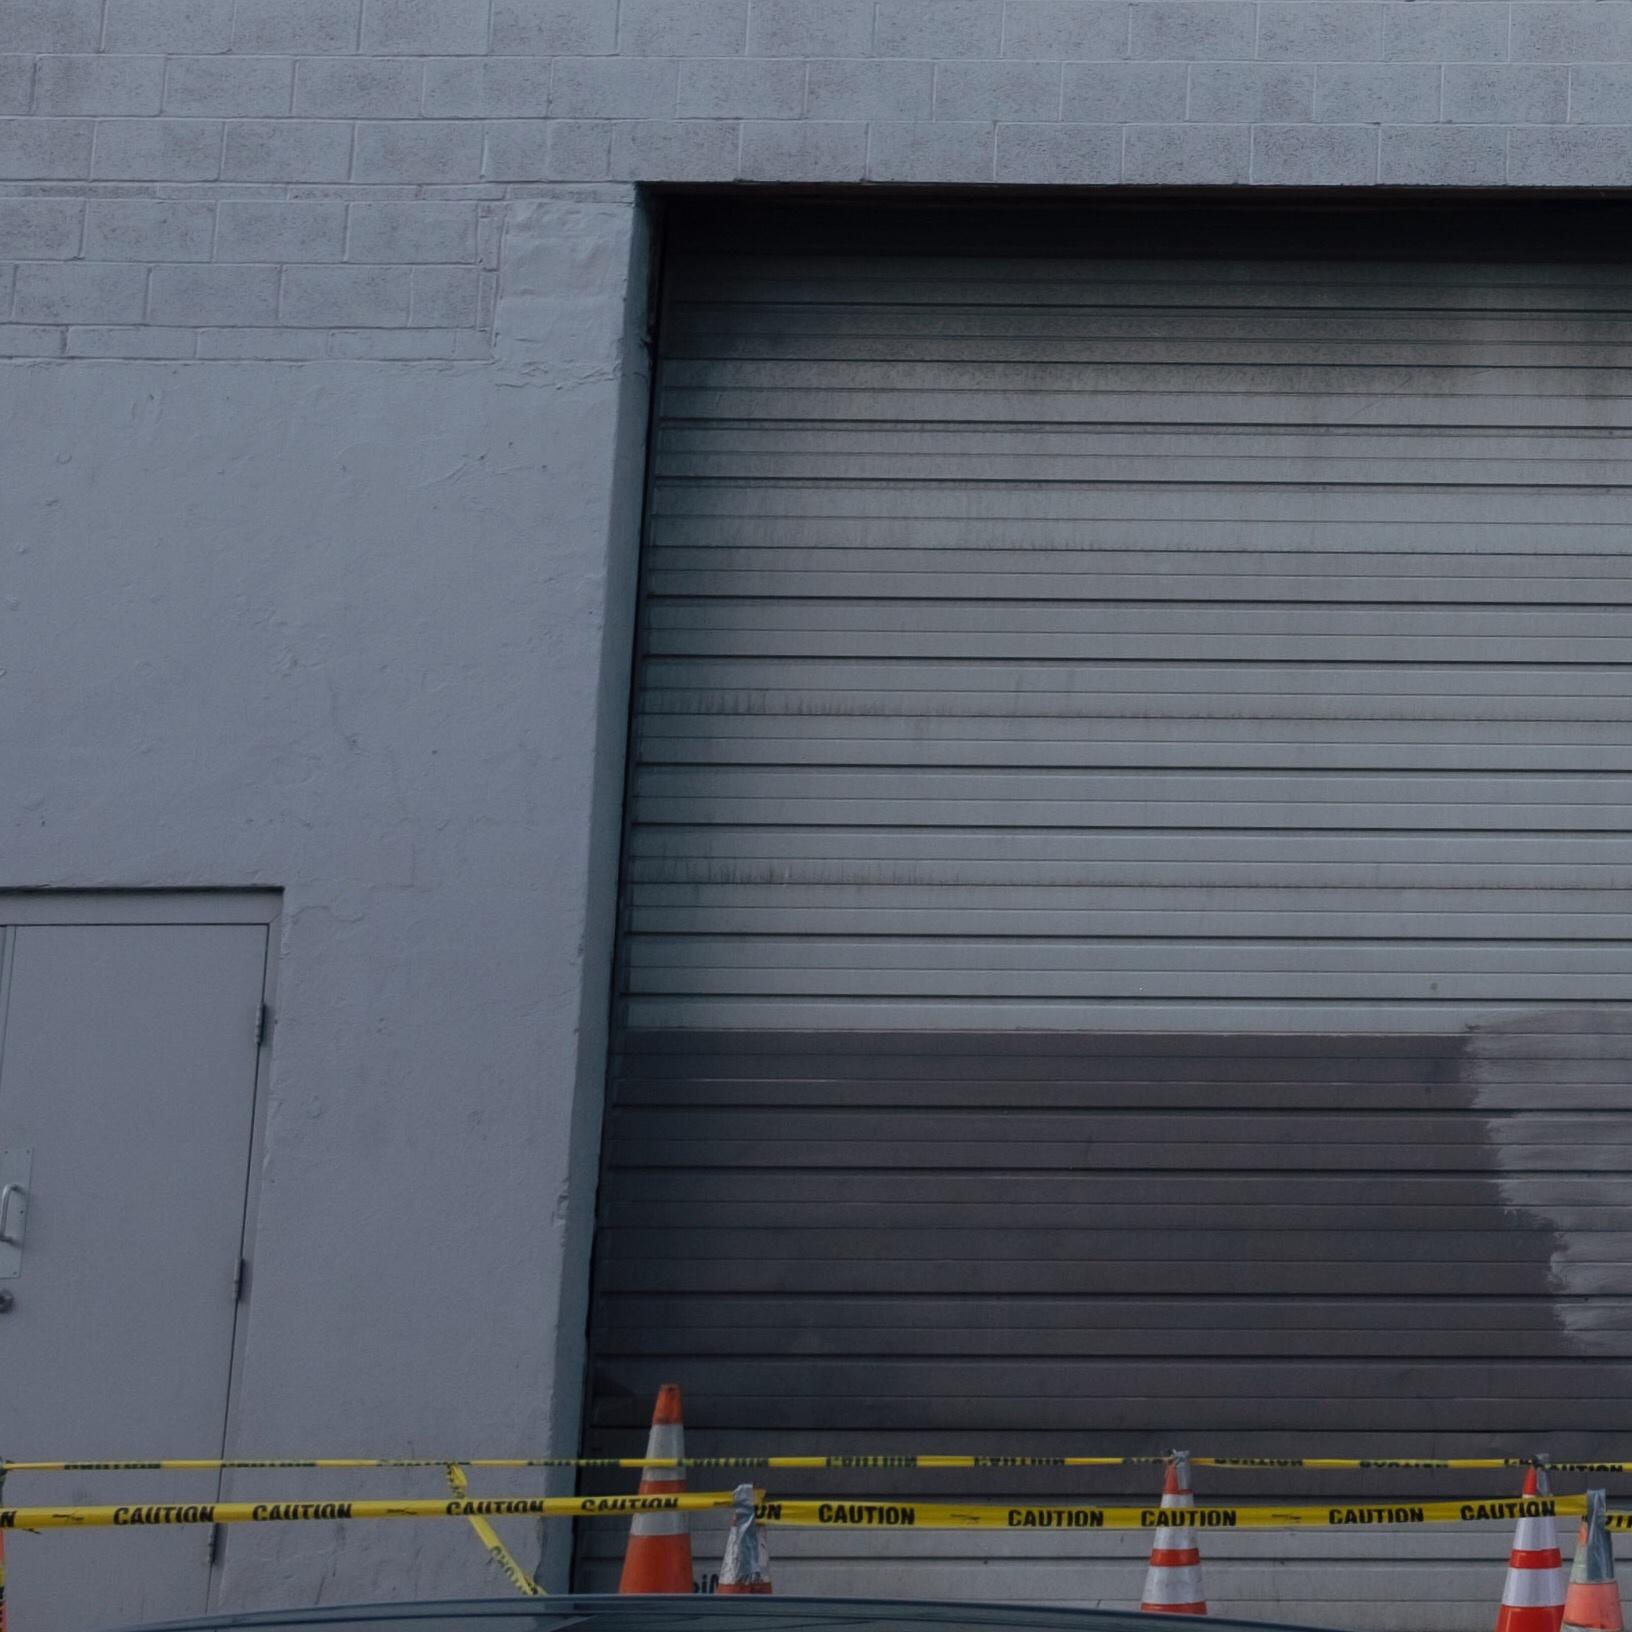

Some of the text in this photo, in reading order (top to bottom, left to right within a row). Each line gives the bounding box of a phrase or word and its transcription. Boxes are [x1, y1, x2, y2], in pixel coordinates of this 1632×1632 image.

[113, 1505, 215, 1526] CAUTION
[252, 1503, 352, 1522] CAUTION
[818, 1500, 1556, 1528] CAUTION CAUTION CAUTION CAUTION CAUTION
